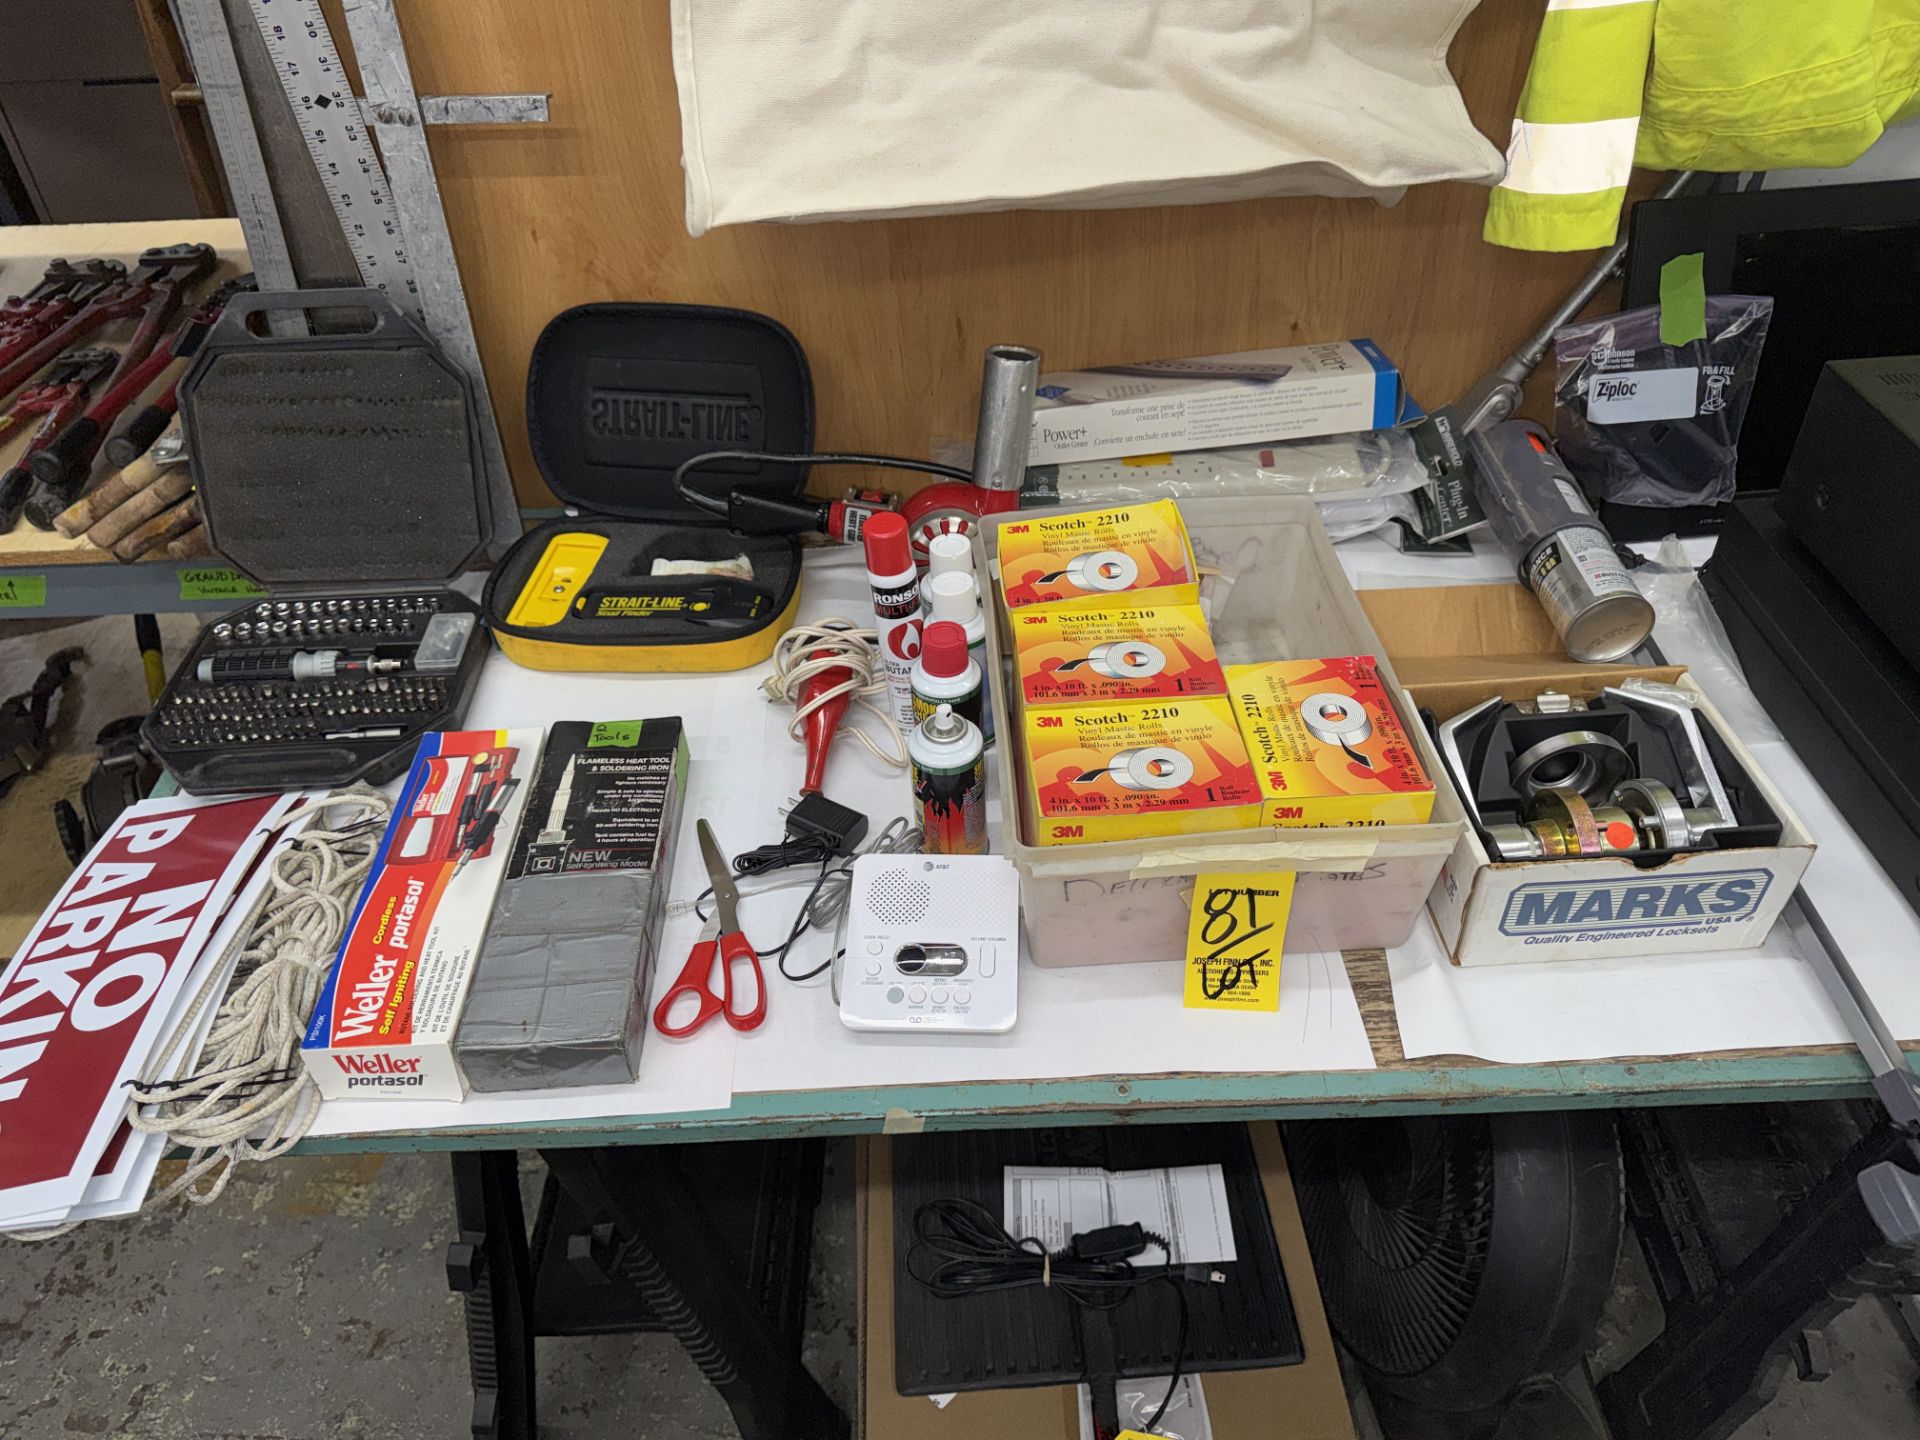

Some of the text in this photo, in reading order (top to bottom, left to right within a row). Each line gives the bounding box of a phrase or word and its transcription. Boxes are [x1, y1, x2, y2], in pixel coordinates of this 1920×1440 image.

[274, 25, 285, 41] 18
[304, 21, 317, 38] 30
[287, 62, 299, 76] 17
[319, 57, 331, 72] 31
[302, 96, 313, 111] 16
[332, 91, 344, 109] 32
[315, 129, 326, 144] 15
[345, 125, 357, 141] 33
[329, 162, 339, 176] 14
[358, 158, 370, 174] 34
[342, 194, 352, 207] 13
[371, 190, 383, 205] 35
[354, 224, 365, 237] 12
[383, 220, 395, 235] 36
[367, 255, 376, 267] 11
[1596, 381, 1637, 401] Ziploc
[1111, 407, 1144, 417] Transforme
[1160, 404, 1175, 414] prise
[1176, 402, 1185, 410] de
[1136, 413, 1159, 422] courant
[1043, 426, 1087, 443] Power+
[1134, 432, 1159, 441] enchufe
[1053, 441, 1089, 449] Outlet Center
[1448, 480, 1470, 520] Plug-In
[1006, 524, 1030, 535] 3M
[1039, 513, 1130, 532] Scotch 2210
[1042, 527, 1115, 540] Vinyl Mastic Rolls
[1042, 538, 1079, 546] Rouleaux
[1093, 535, 1119, 543] mastic
[1132, 528, 1158, 539] vinyle
[1083, 541, 1118, 551] mastique
[183, 572, 228, 583] GRAND
[873, 584, 919, 603] RONSO
[600, 596, 685, 608] STRAIT-LINE
[1058, 610, 1155, 623] Scotch 2210
[1036, 717, 1063, 728] 3M
[1074, 708, 1179, 727] Scotch 2210
[1077, 722, 1163, 737] Vinyl Mastic Rolls
[1078, 733, 1122, 742] Rouleaux
[1138, 729, 1168, 738] mastic
[1185, 724, 1213, 735] vinyle
[1241, 694, 1278, 764] Scotch 2210
[594, 732, 630, 742] Tools
[1080, 741, 1111, 749] Rollos
[1126, 736, 1168, 747] mastique
[1267, 771, 1288, 791] 3M
[1058, 796, 1073, 804] in.
[1122, 793, 1143, 801] .090
[1206, 787, 1217, 802] 1
[1050, 797, 1190, 813] 101.6 mm 2.29 mm
[1273, 807, 1303, 819] 3M
[1051, 825, 1084, 839] 3M
[568, 851, 611, 862] NEW
[566, 862, 619, 870] Self-Igniting
[1514, 879, 1756, 927] MARKS
[373, 896, 397, 945] Cordless
[1704, 916, 1732, 926] USA
[1524, 925, 1719, 945] Quality Engineered Locksets
[0, 814, 196, 1101] PARKIN
[70, 880, 217, 1032] NO
[334, 954, 399, 1041] Weller
[389, 879, 425, 949] portasol
[423, 950, 433, 965] HEAT
[1192, 957, 1222, 965] JOSEPH
[379, 961, 415, 1035] Self Igniting
[331, 1053, 421, 1074] Weller
[348, 1075, 424, 1088] portasol
